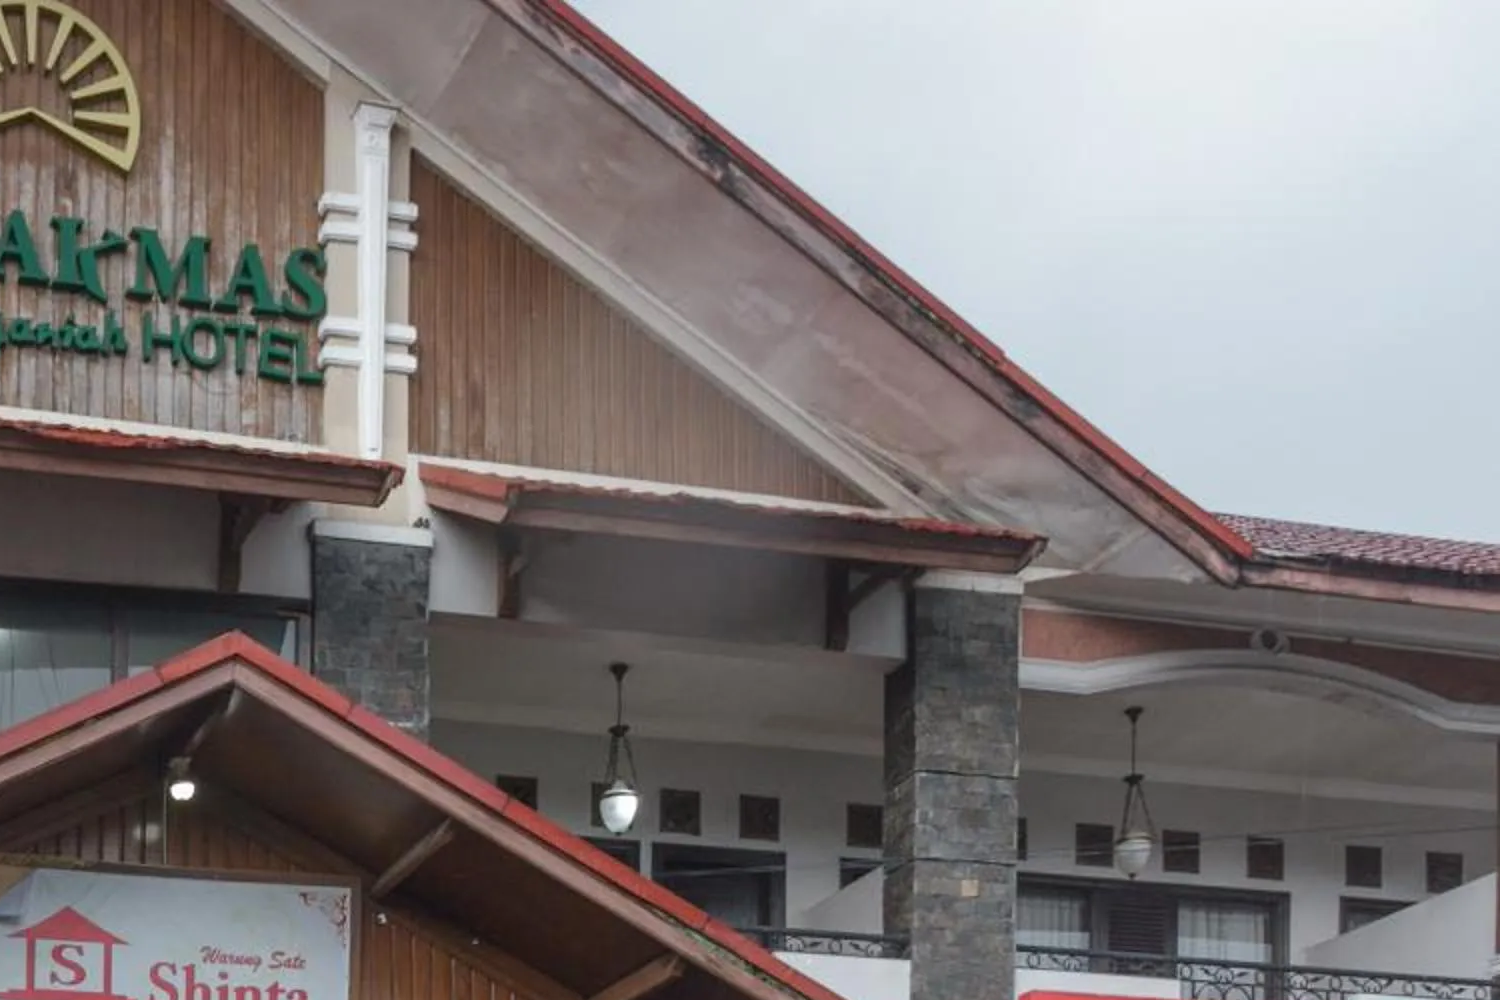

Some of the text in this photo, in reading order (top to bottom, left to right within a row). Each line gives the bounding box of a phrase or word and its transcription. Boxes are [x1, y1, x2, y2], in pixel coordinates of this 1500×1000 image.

[142, 314, 324, 384] HOTEL
[49, 943, 87, 986] S
[200, 946, 307, 970] Warung Sate
